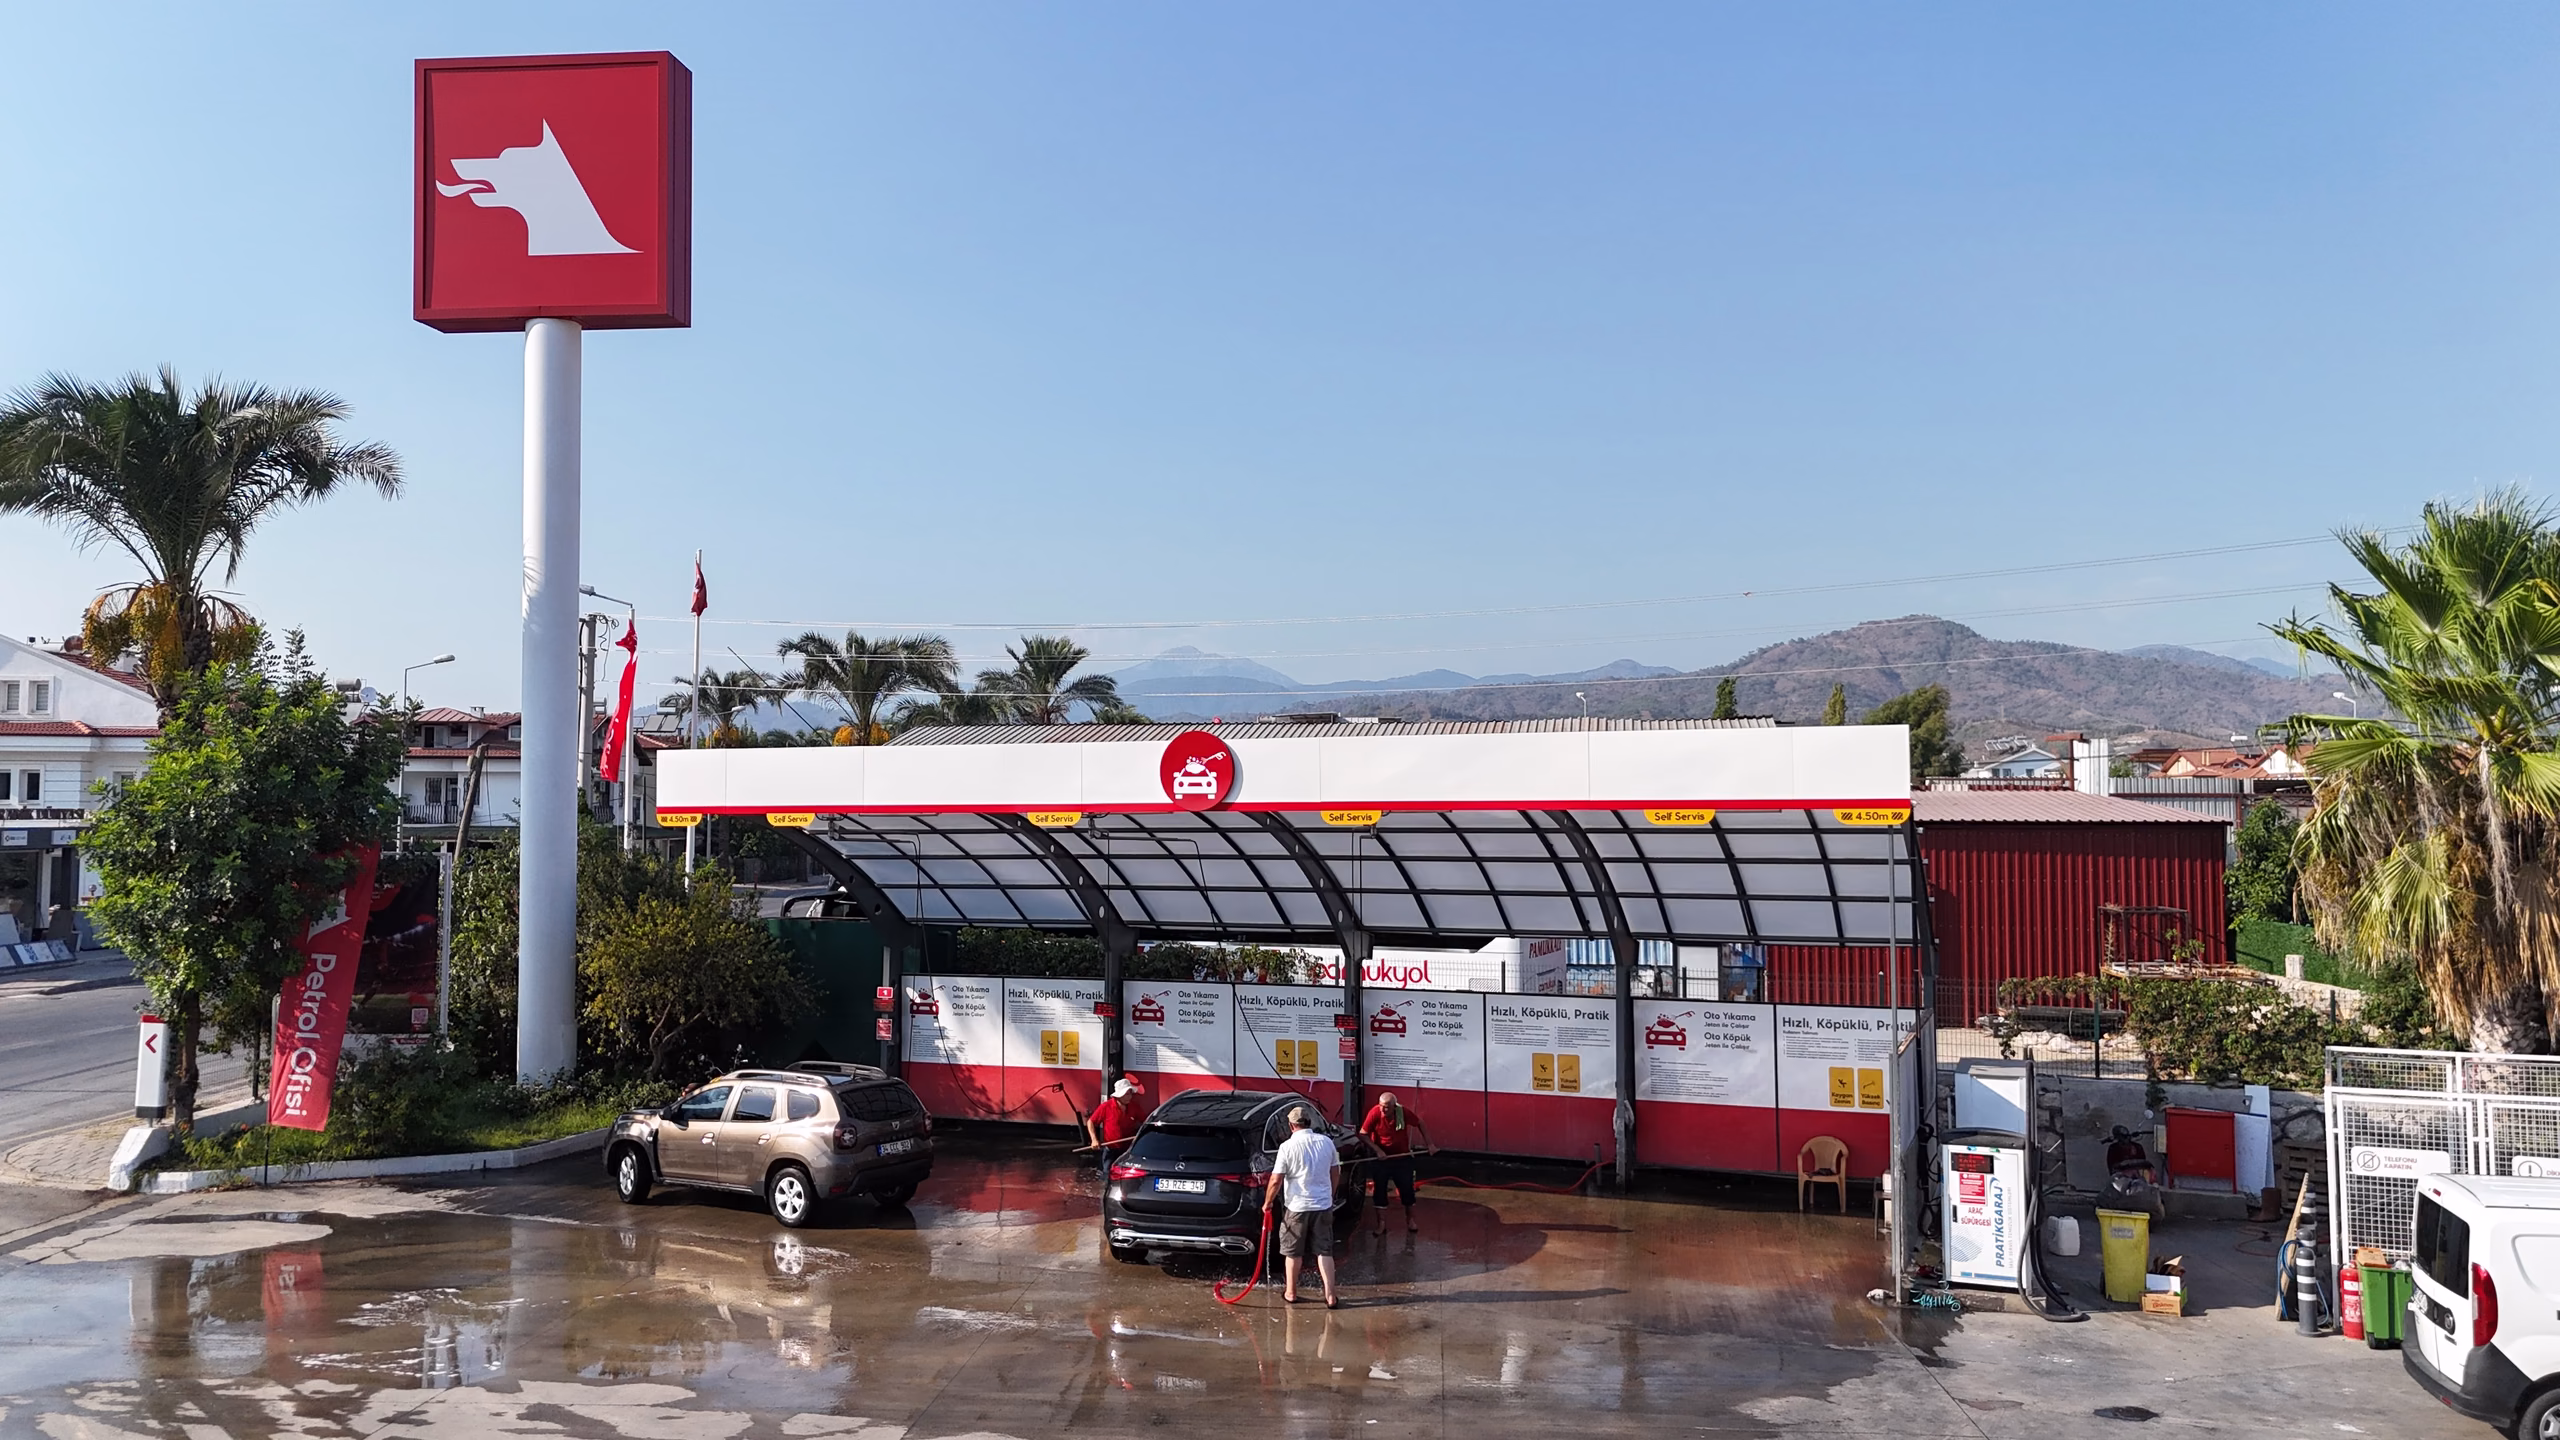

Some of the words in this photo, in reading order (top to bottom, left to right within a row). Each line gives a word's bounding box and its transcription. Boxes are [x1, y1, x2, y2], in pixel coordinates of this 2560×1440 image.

[668, 815, 690, 823] 4.50m
[773, 815, 787, 824] Self
[787, 814, 808, 823] Servis
[1035, 814, 1049, 823] Self
[1051, 814, 1074, 822] Servis
[1328, 812, 1345, 822] Self
[1346, 812, 1373, 822] Servis
[1654, 811, 1673, 822] Self
[1674, 811, 1705, 822] Servis
[1855, 811, 1889, 821] 4.50m
[951, 985, 964, 993] Oto
[965, 985, 990, 993] Yıkama
[296, 953, 337, 1039] Petrol
[1008, 988, 1030, 1000] Hızlı,
[1033, 989, 1072, 1001] Köpüklü,
[1076, 991, 1104, 1001] Pratik
[1178, 990, 1191, 998] Oto
[1193, 991, 1219, 999] Yıkama
[1239, 995, 1264, 1006] Hızlı,
[1266, 996, 1310, 1008] Köpüklü,
[1313, 997, 1344, 1008] Pratik
[1421, 1000, 1437, 1008] Oto
[1438, 1001, 1468, 1010] Yıkama
[965, 1003, 986, 1012] Köpük
[1491, 1005, 1518, 1018] Hızlı,
[1521, 1007, 1570, 1020] Köpüklü,
[1574, 1009, 1610, 1020] Pratik
[1193, 1009, 1215, 1018] Köpük
[1703, 1011, 1720, 1020] Oto
[1722, 1012, 1756, 1021] Yıkama
[1422, 1020, 1437, 1028] Oto
[1438, 1021, 1464, 1030] Köpük
[1782, 1017, 1812, 1030] Hızlı,
[1817, 1018, 1872, 1032] Köpüklü,
[1704, 1032, 1721, 1040] Oto
[1723, 1032, 1751, 1043] Köpük
[285, 1047, 317, 1116] Ofisi
[2384, 1155, 2417, 1163] TELEFONU
[1160, 1180, 1170, 1189] 53
[1173, 1180, 1187, 1189] RZE
[1968, 1207, 1983, 1216] ARAÇ
[1961, 1216, 1992, 1227] SÜPÜRGESİ
[1992, 1186, 2004, 1267] PRATİKGARAJ
